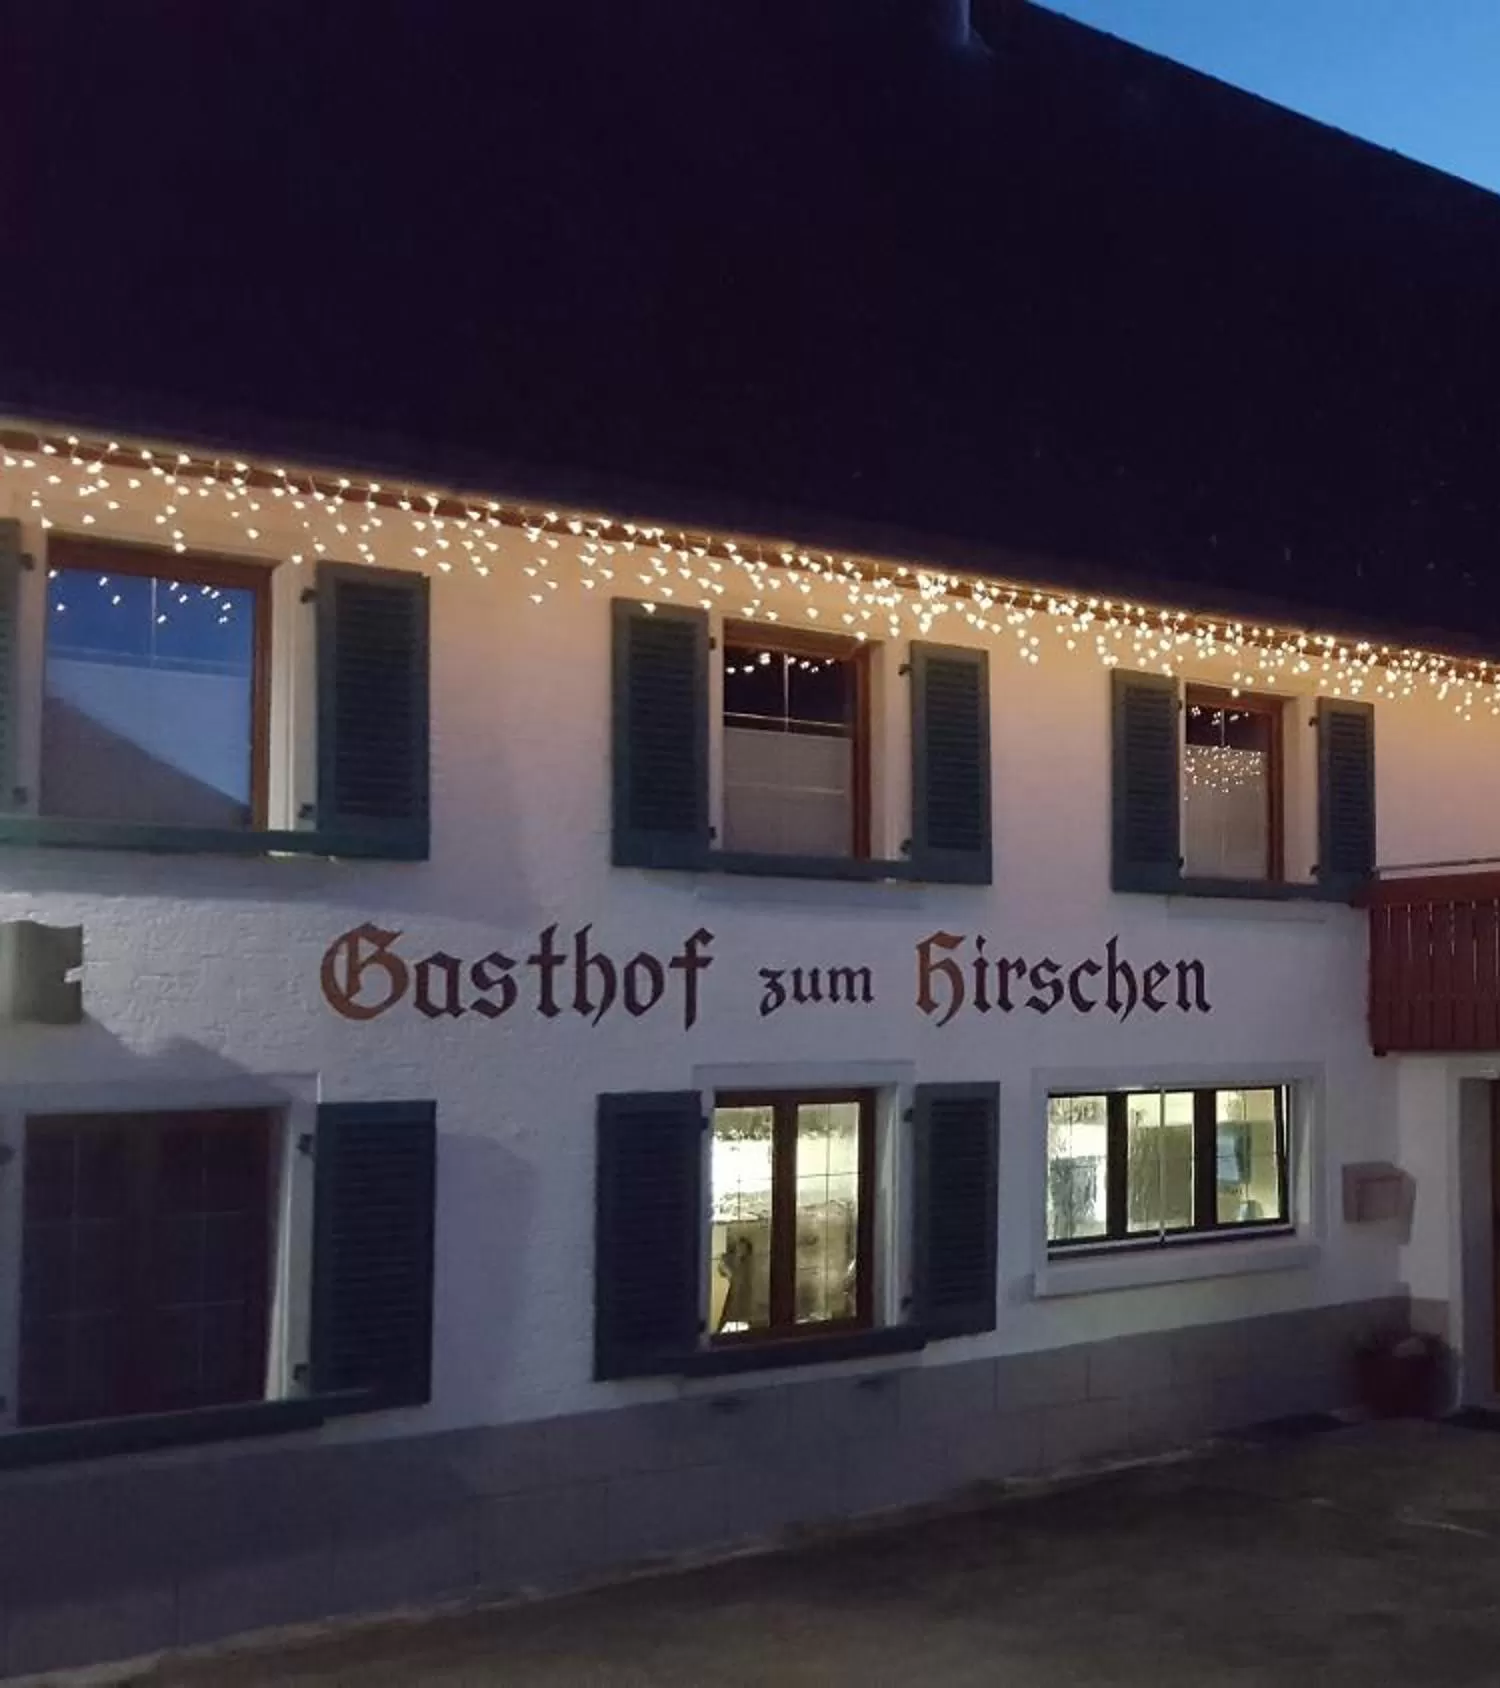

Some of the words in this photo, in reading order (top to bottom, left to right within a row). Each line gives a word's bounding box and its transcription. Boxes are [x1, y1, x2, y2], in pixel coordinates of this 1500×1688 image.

[320, 921, 715, 1030] Gasthof
[757, 964, 874, 1017] zum
[914, 930, 1213, 1026] Hirschen
